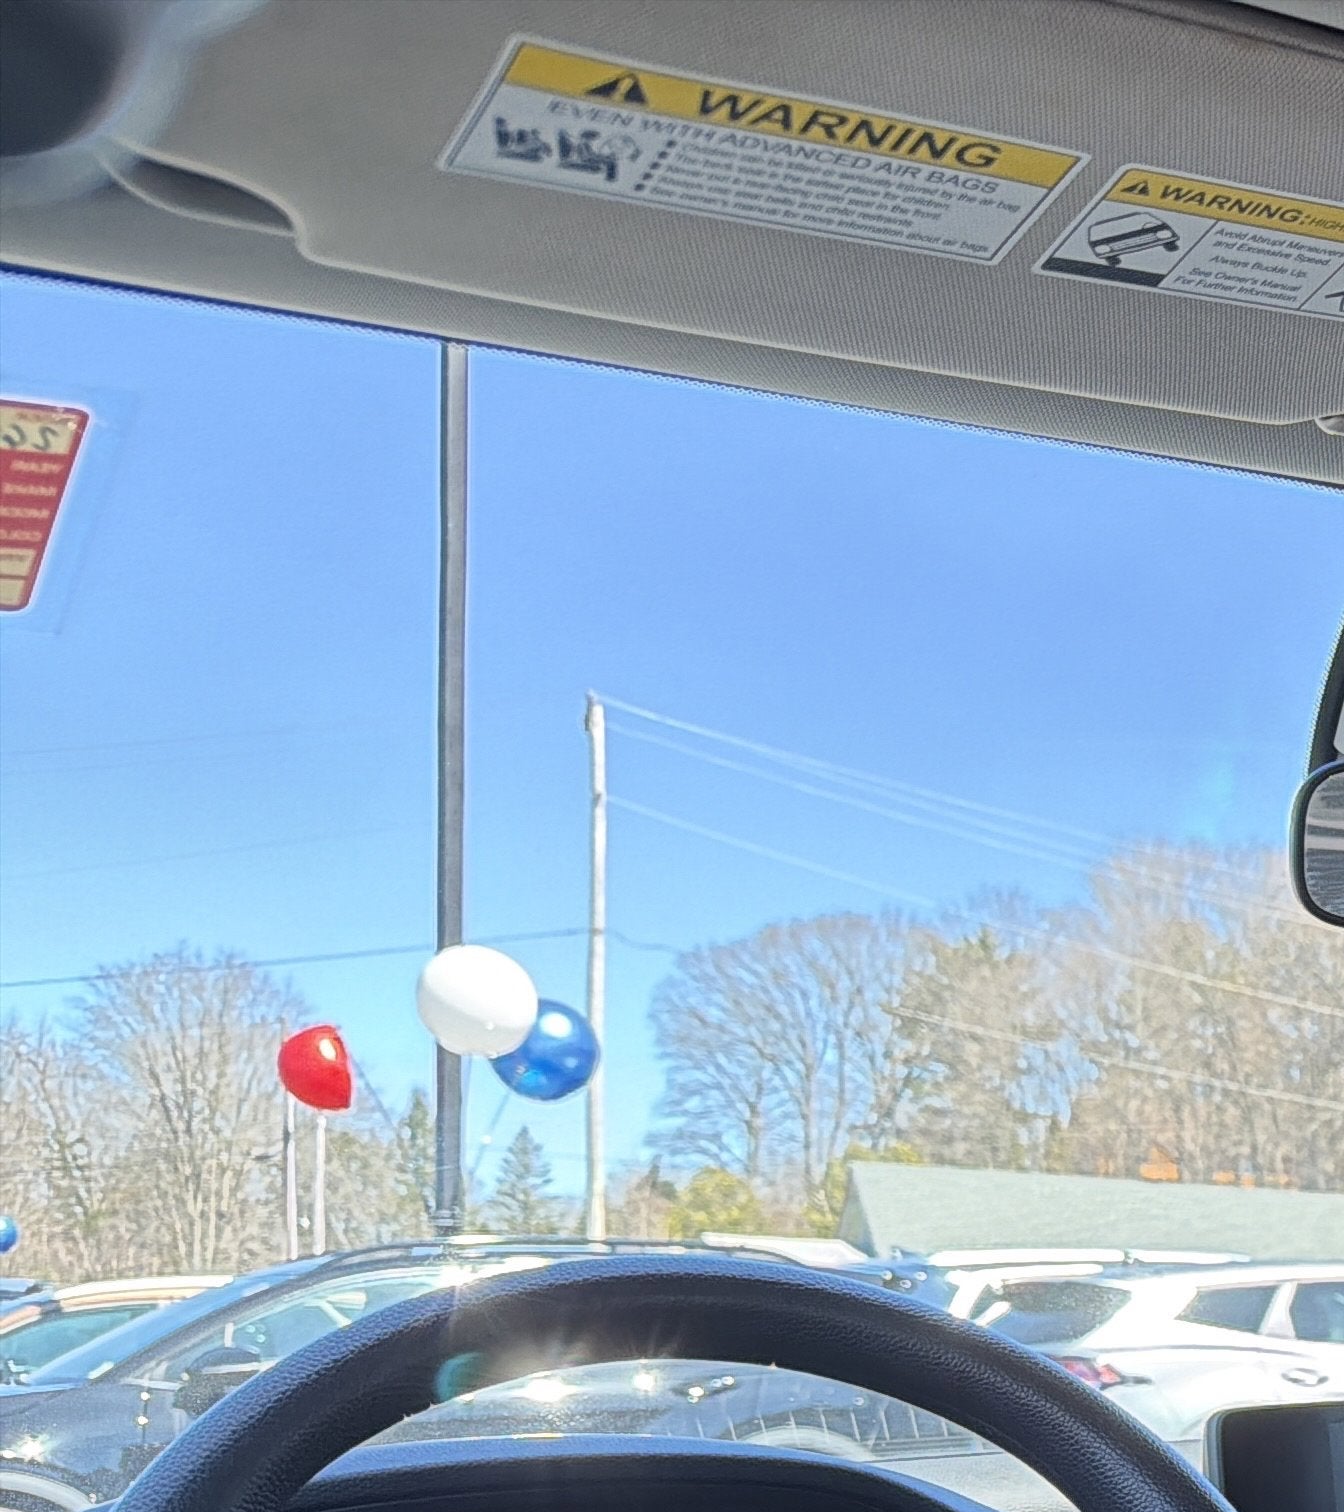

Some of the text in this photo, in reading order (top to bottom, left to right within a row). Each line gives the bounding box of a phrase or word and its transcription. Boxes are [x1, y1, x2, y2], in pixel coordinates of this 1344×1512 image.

[699, 90, 1000, 168] WARNING
[547, 100, 999, 194] EVEN WITH ADVANCED AIR BAGS
[1160, 185, 1311, 225] WARNING:
[1213, 228, 1250, 241] Avoid
[1246, 234, 1287, 247] Abrupt
[1212, 240, 1238, 250] and
[1236, 243, 1293, 260] Excessive
[1208, 255, 1250, 269] Always
[1250, 261, 1289, 275] Buckle
[1173, 275, 1195, 285] For
[1194, 279, 1237, 292] Further
[1188, 267, 1302, 292] See Owner's Manual
